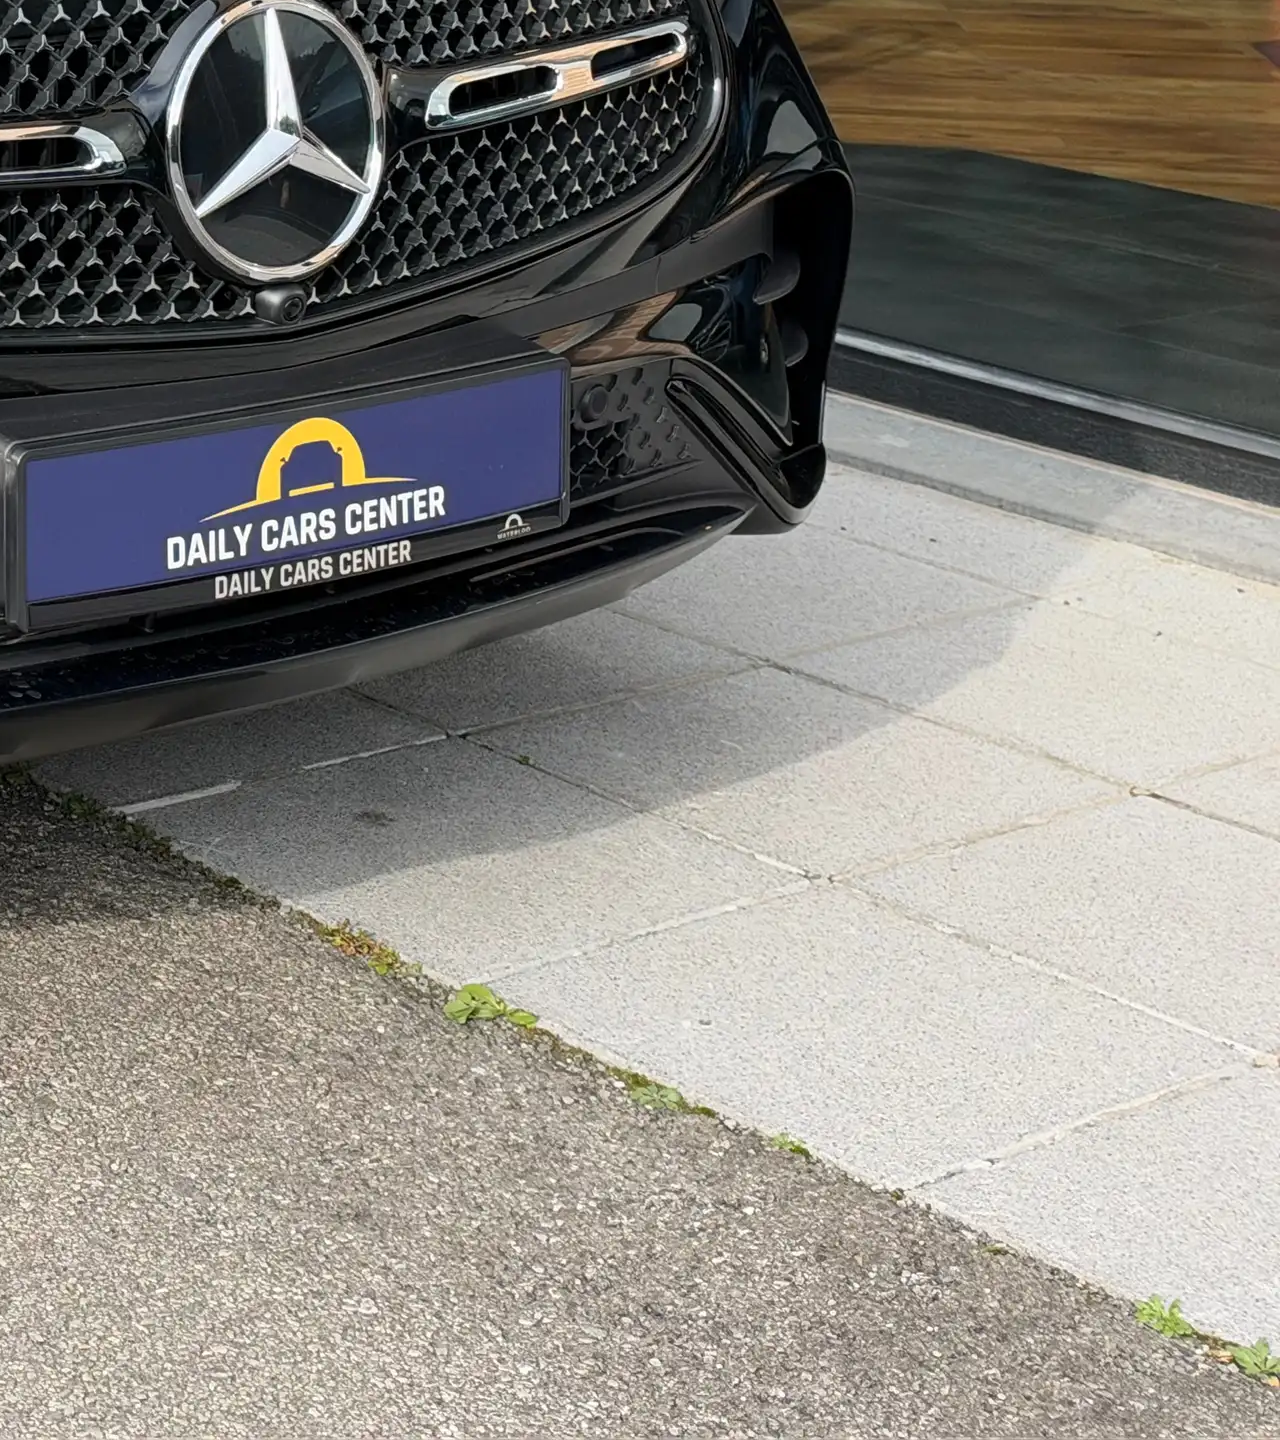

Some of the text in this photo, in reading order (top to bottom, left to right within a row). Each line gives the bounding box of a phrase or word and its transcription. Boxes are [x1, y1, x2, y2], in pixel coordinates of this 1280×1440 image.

[167, 485, 446, 570] DAILY CARS CENTER
[497, 527, 532, 540] WATERLOO
[215, 540, 412, 599] DAILY CARS CENTER
